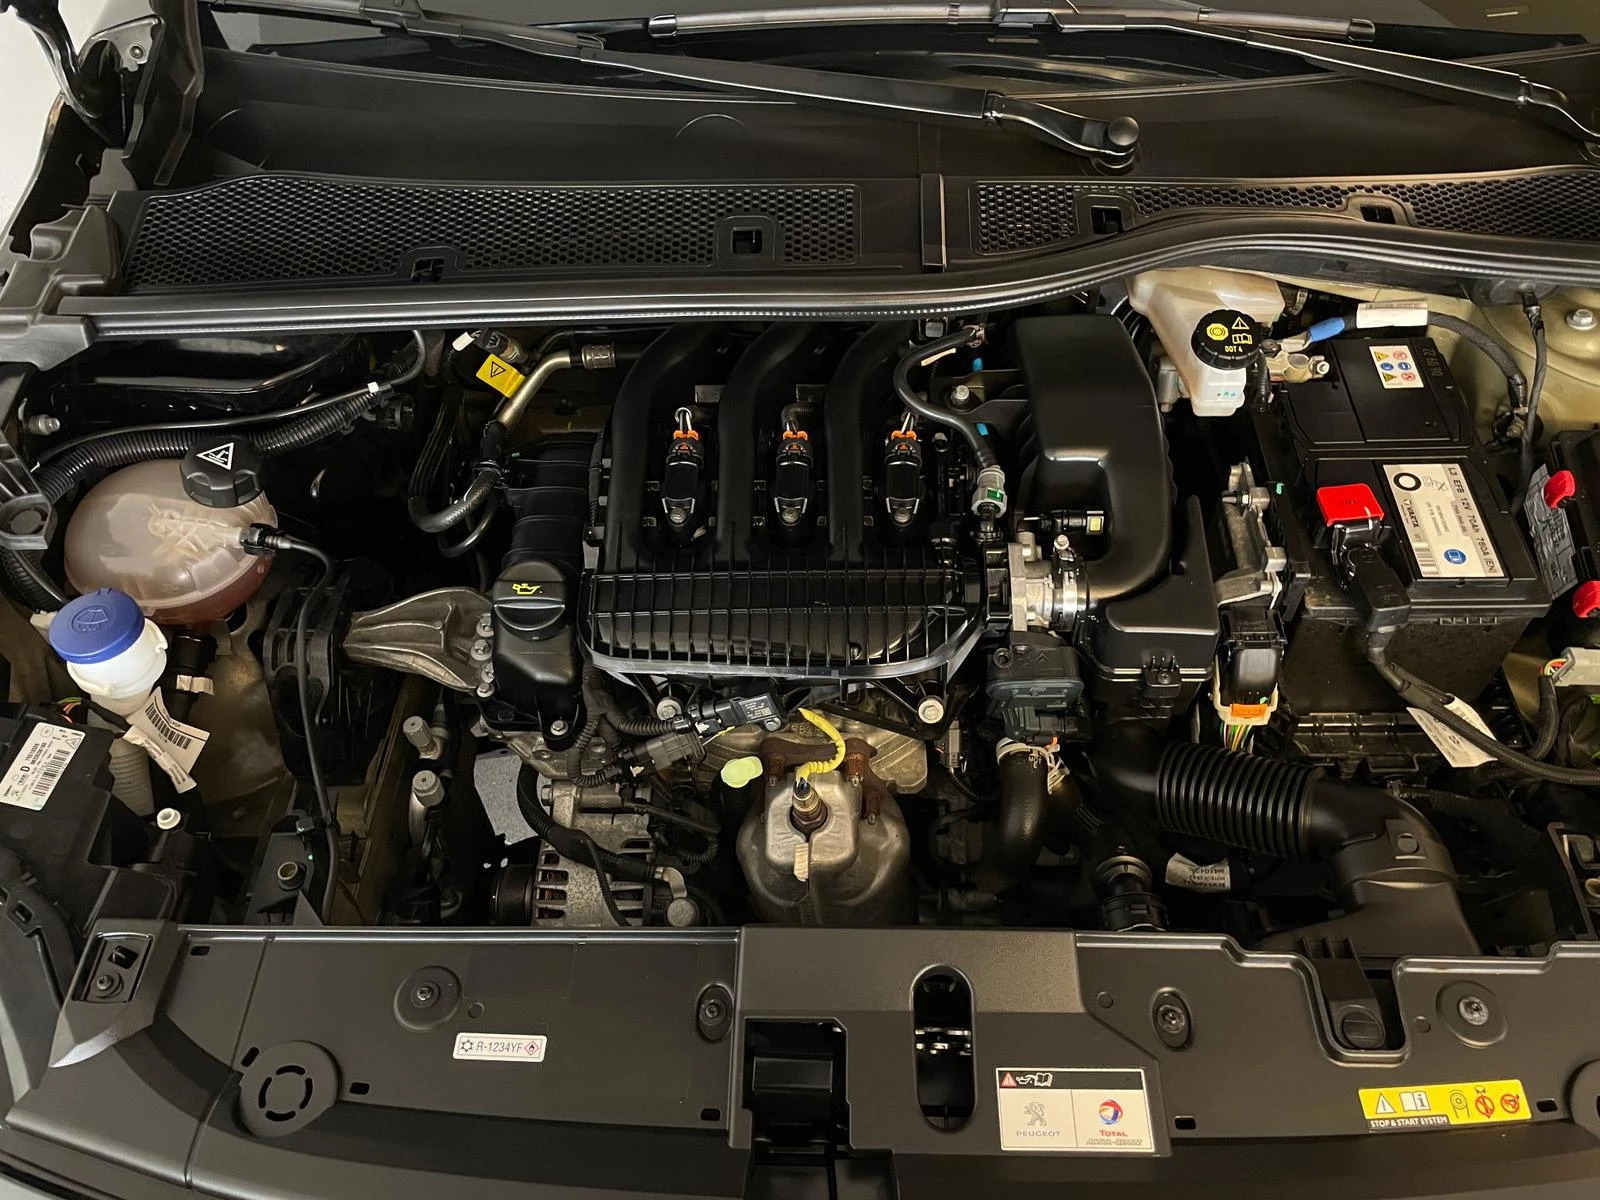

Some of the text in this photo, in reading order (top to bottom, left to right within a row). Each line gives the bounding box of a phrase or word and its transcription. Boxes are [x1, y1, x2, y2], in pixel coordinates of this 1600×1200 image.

[1224, 345, 1237, 353] DOT
[1406, 503, 1419, 528] VARTA
[1448, 467, 1457, 476] L3
[1453, 479, 1465, 493] EFB
[1460, 497, 1473, 511] 12V
[1467, 514, 1480, 533] 70Ah
[1482, 556, 1497, 573] (EN)
[476, 1041, 523, 1053] R-1234YF
[1370, 1116, 1448, 1128] STOP & START SYSTEM
[1099, 1129, 1128, 1137] TOTAL
